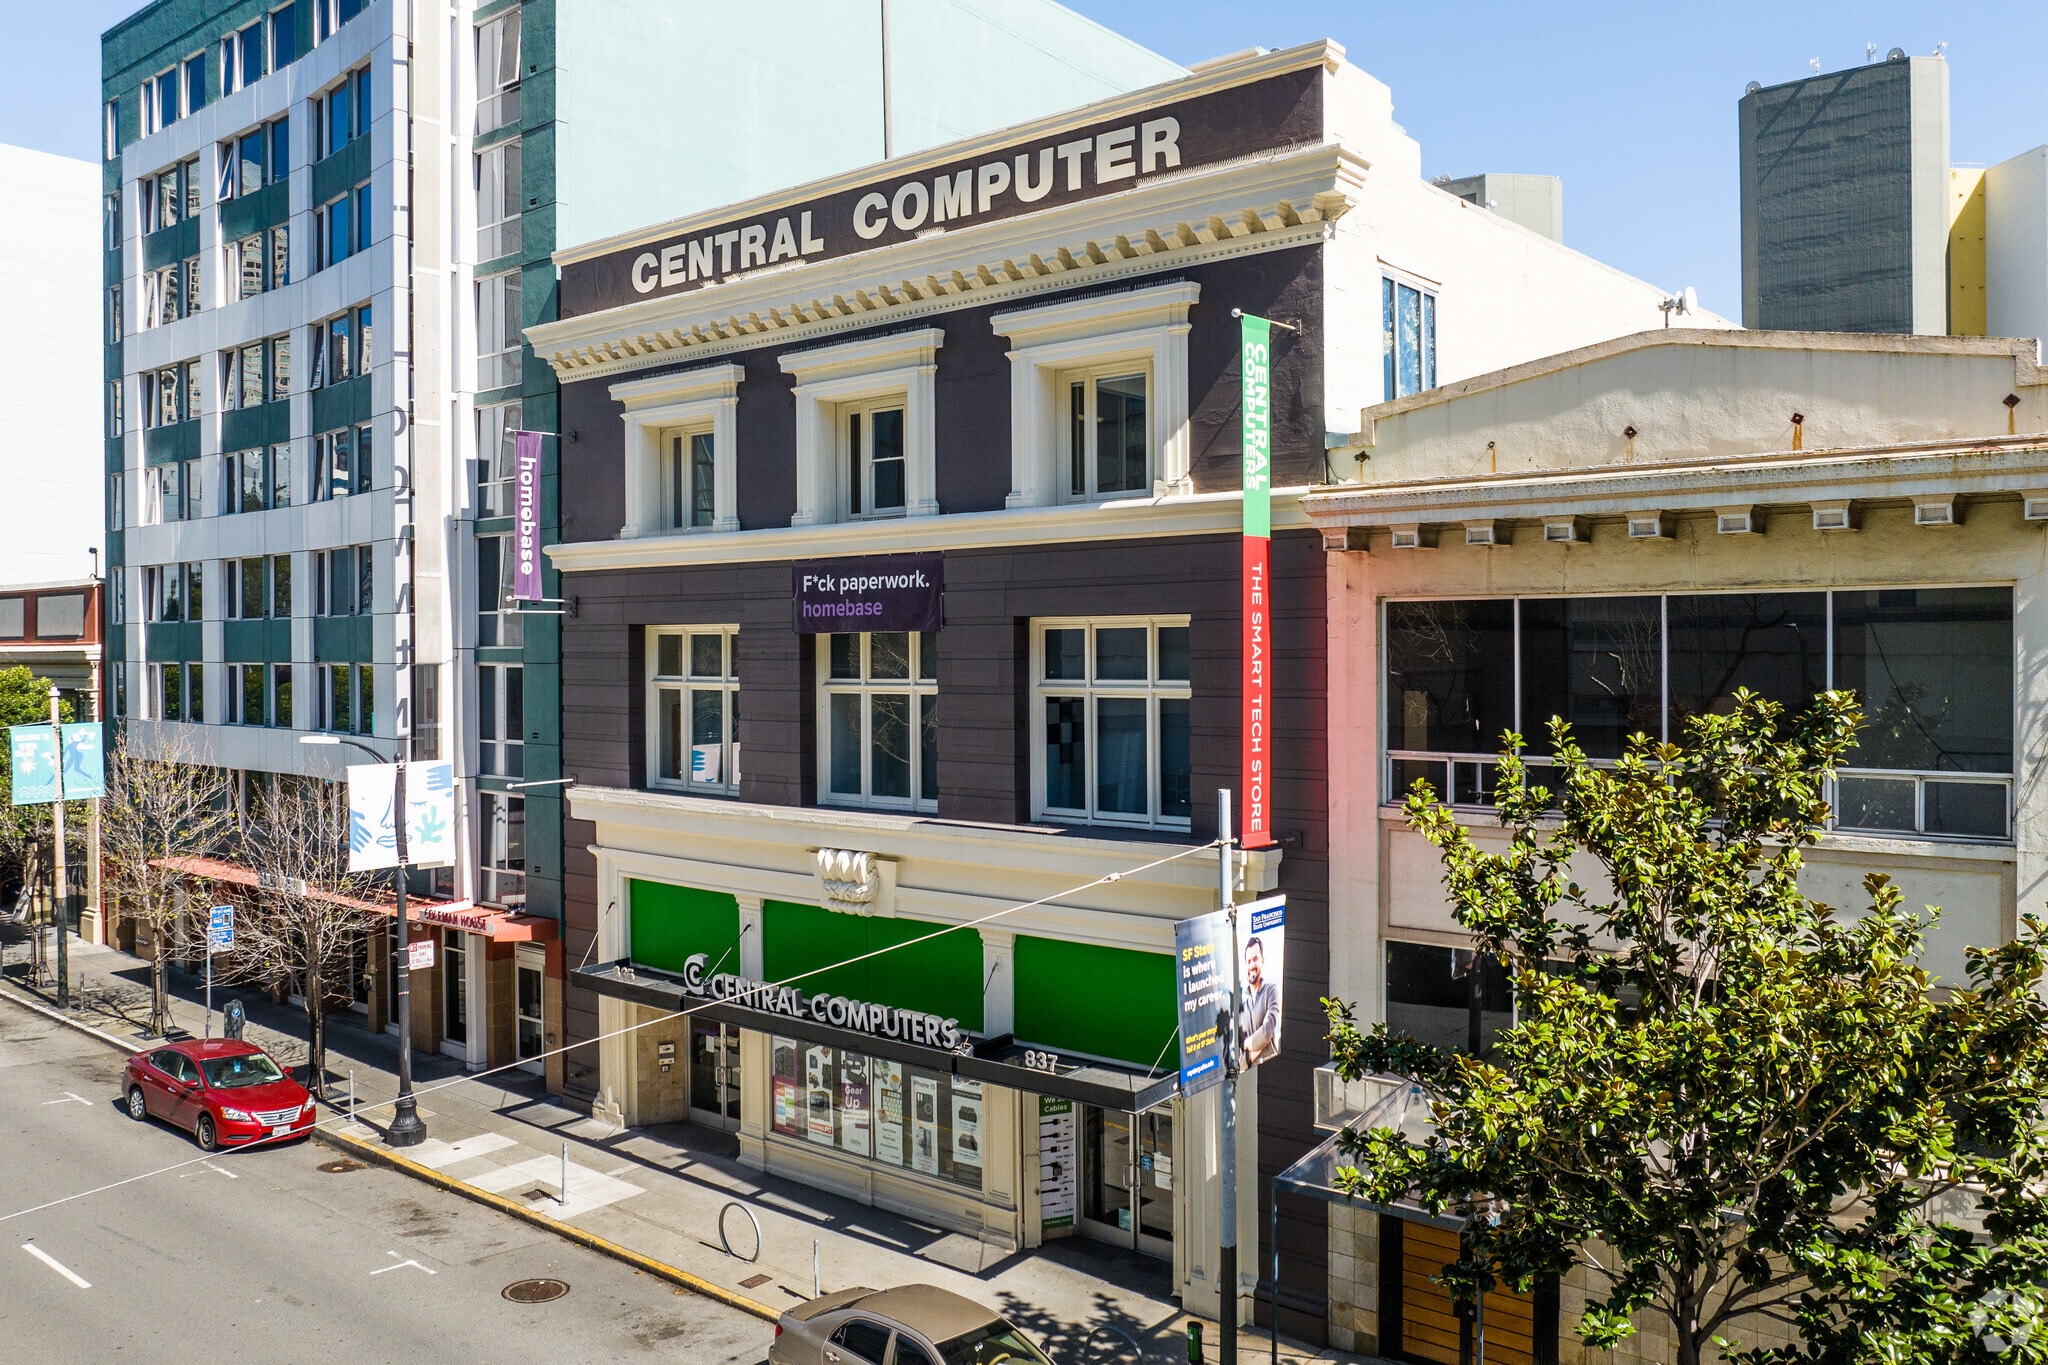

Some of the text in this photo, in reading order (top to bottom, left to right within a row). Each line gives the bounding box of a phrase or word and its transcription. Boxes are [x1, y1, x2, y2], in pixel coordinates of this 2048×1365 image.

[631, 116, 1182, 293] CENTRAL COMPUTER
[1245, 341, 1256, 490] COMPUTERS
[1255, 343, 1268, 491] CENTRAL
[520, 456, 537, 576] homebase
[839, 570, 930, 595] paperwork.
[802, 598, 883, 618] homebase
[1251, 562, 1262, 832] THE SMART TECH STORE
[460, 914, 487, 931] HOUSE
[1261, 909, 1283, 921] FRANCISCO
[1182, 943, 1215, 962] SF State
[1183, 960, 1216, 979] is where
[1188, 971, 1225, 994] launched
[711, 972, 808, 1018] CENTRAL
[811, 993, 961, 1050] COMPUTERS
[1184, 998, 1198, 1013] my
[1024, 1050, 1058, 1073] 837
[845, 1085, 863, 1095] Gear
[913, 1080, 930, 1089] iPhone
[845, 1096, 860, 1111] Up
[1044, 1104, 1068, 1113] Cables
